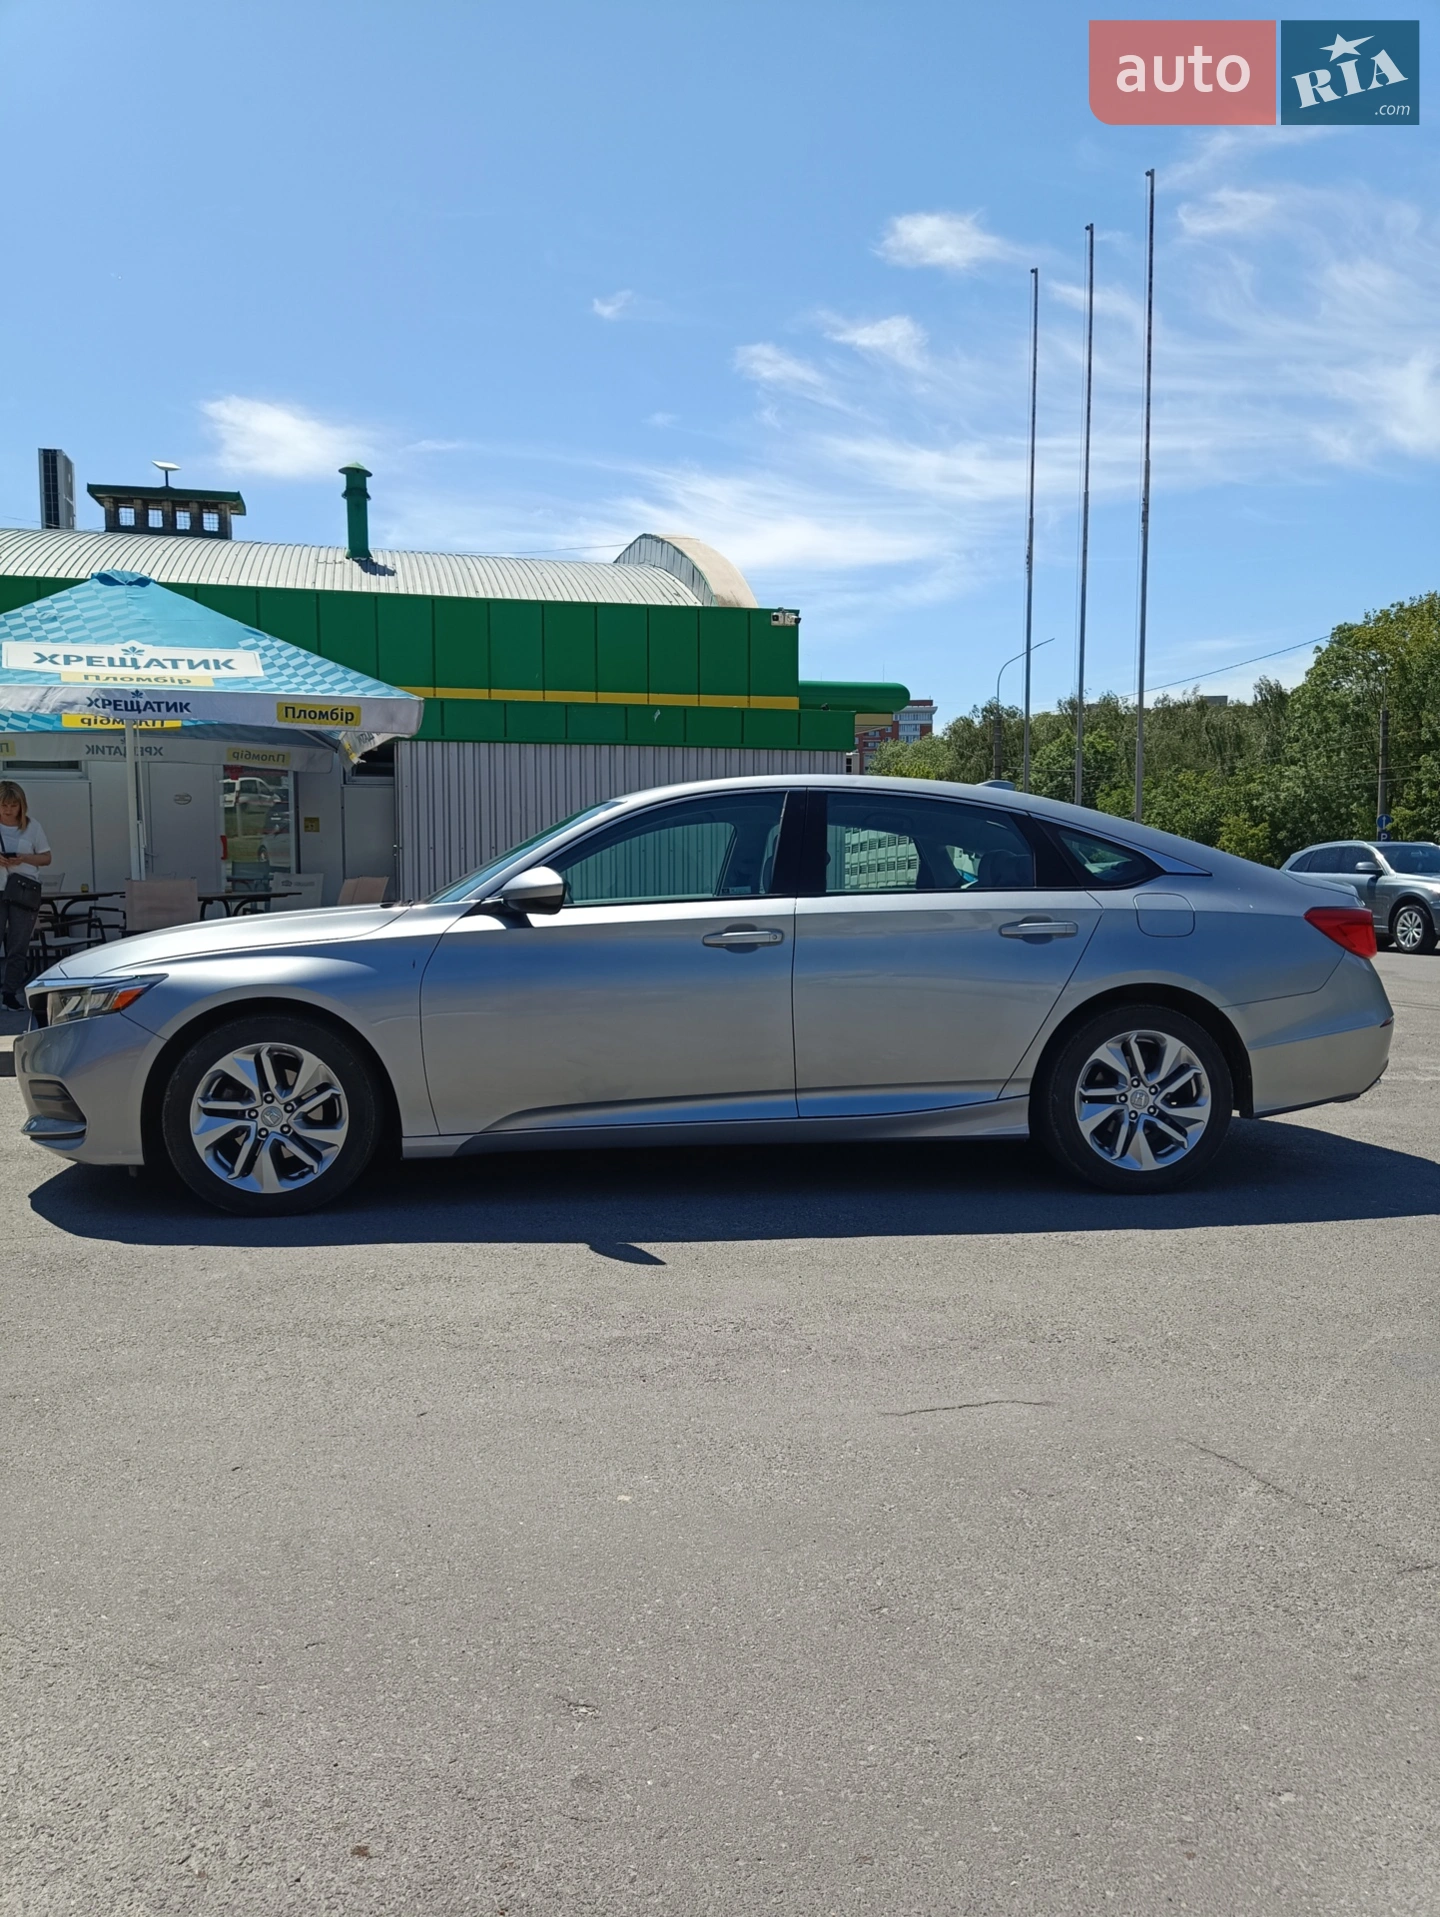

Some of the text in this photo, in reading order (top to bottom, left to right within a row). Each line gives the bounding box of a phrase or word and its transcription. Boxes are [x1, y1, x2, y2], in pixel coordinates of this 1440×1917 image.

[33, 651, 237, 670] ХРЕЩАТИК
[84, 674, 192, 685] Пломбір
[86, 697, 192, 714] ХРЕЩАТИК
[284, 706, 355, 724] Пломбір
[1381, 832, 1388, 841] P
